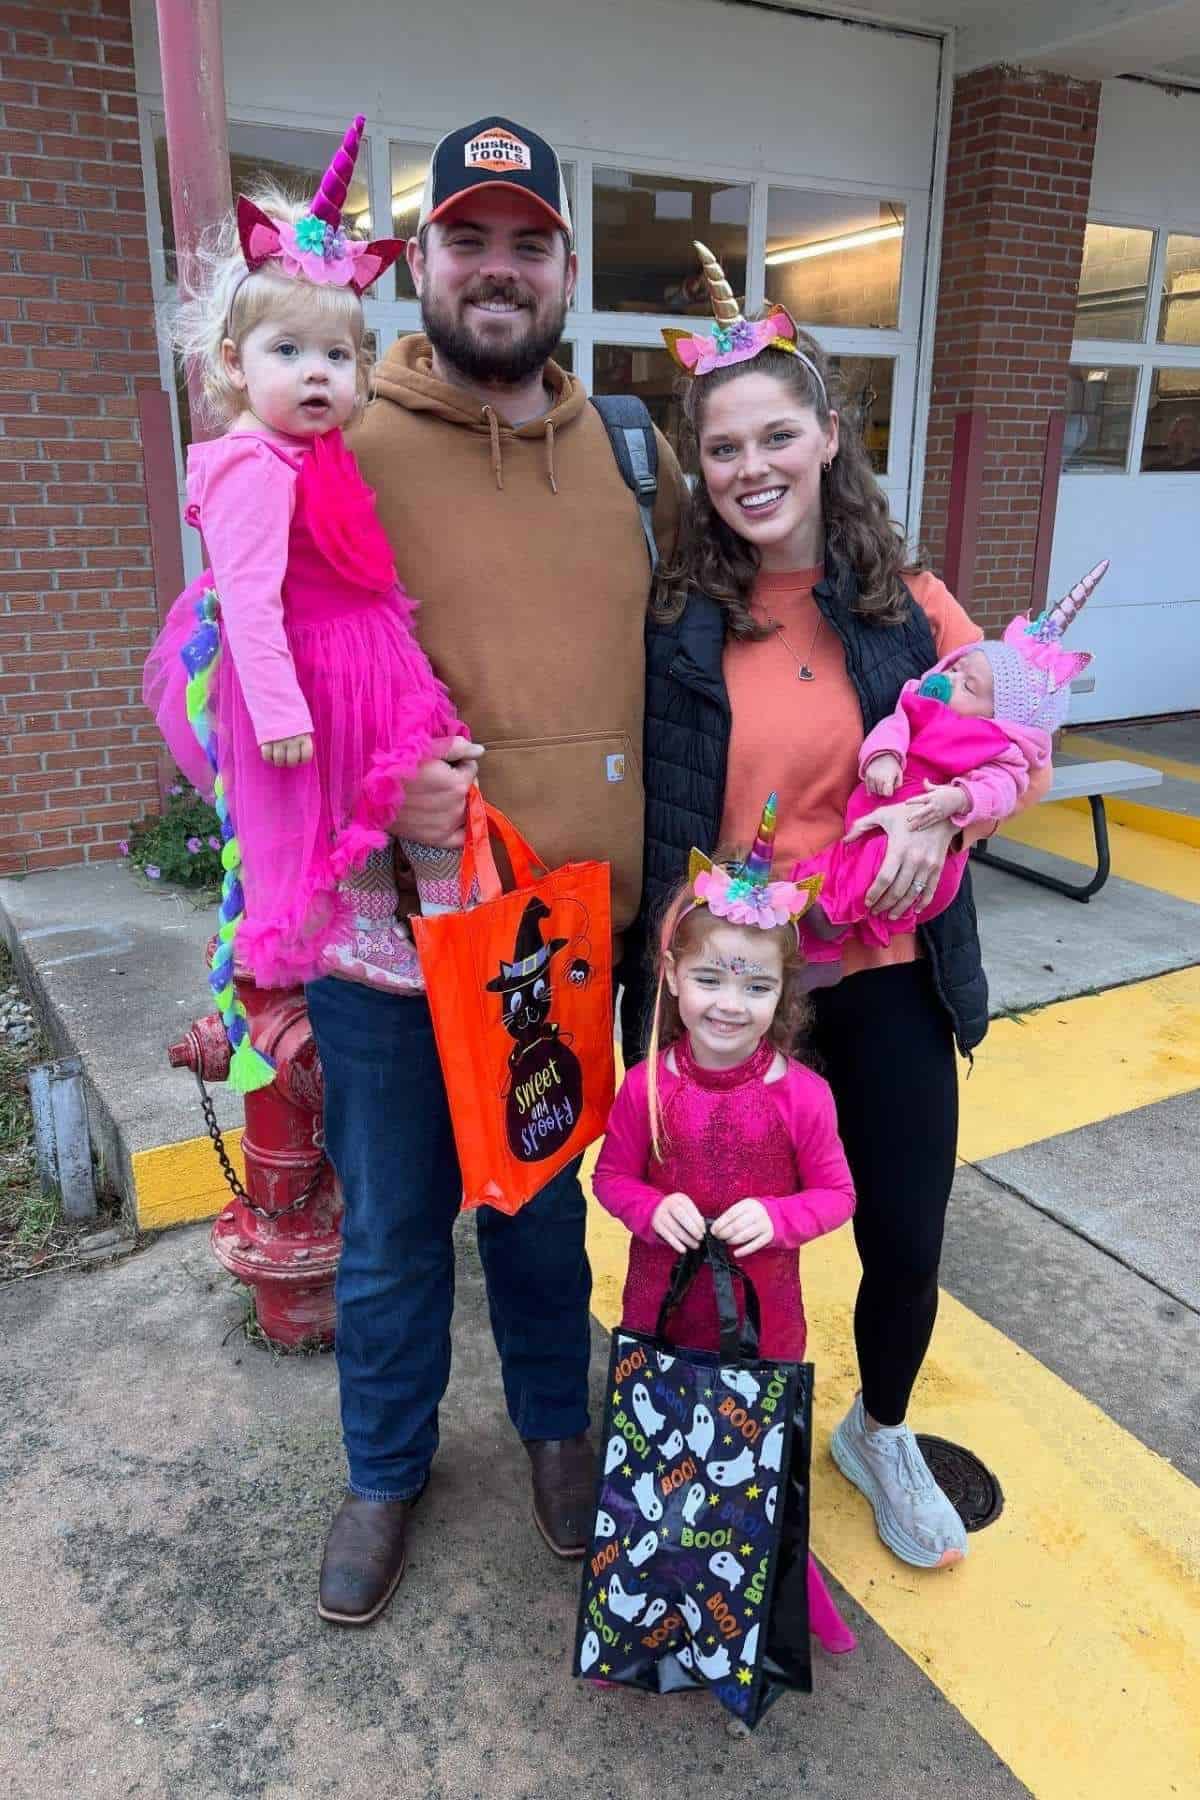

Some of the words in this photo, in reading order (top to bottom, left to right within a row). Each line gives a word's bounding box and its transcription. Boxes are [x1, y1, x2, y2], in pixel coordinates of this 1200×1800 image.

[470, 139, 523, 154] Huskie
[515, 1058, 561, 1114] sweet
[531, 1095, 549, 1120] and
[521, 1096, 573, 1156] spooky
[613, 1411, 651, 1460] BOO!
[718, 1396, 762, 1444] BOO!
[660, 1457, 697, 1496] BOO!
[591, 1540, 620, 1577] BOO!
[680, 1528, 733, 1549] BOO!
[588, 1596, 621, 1647] BOO!
[705, 1591, 743, 1641] BOO!
